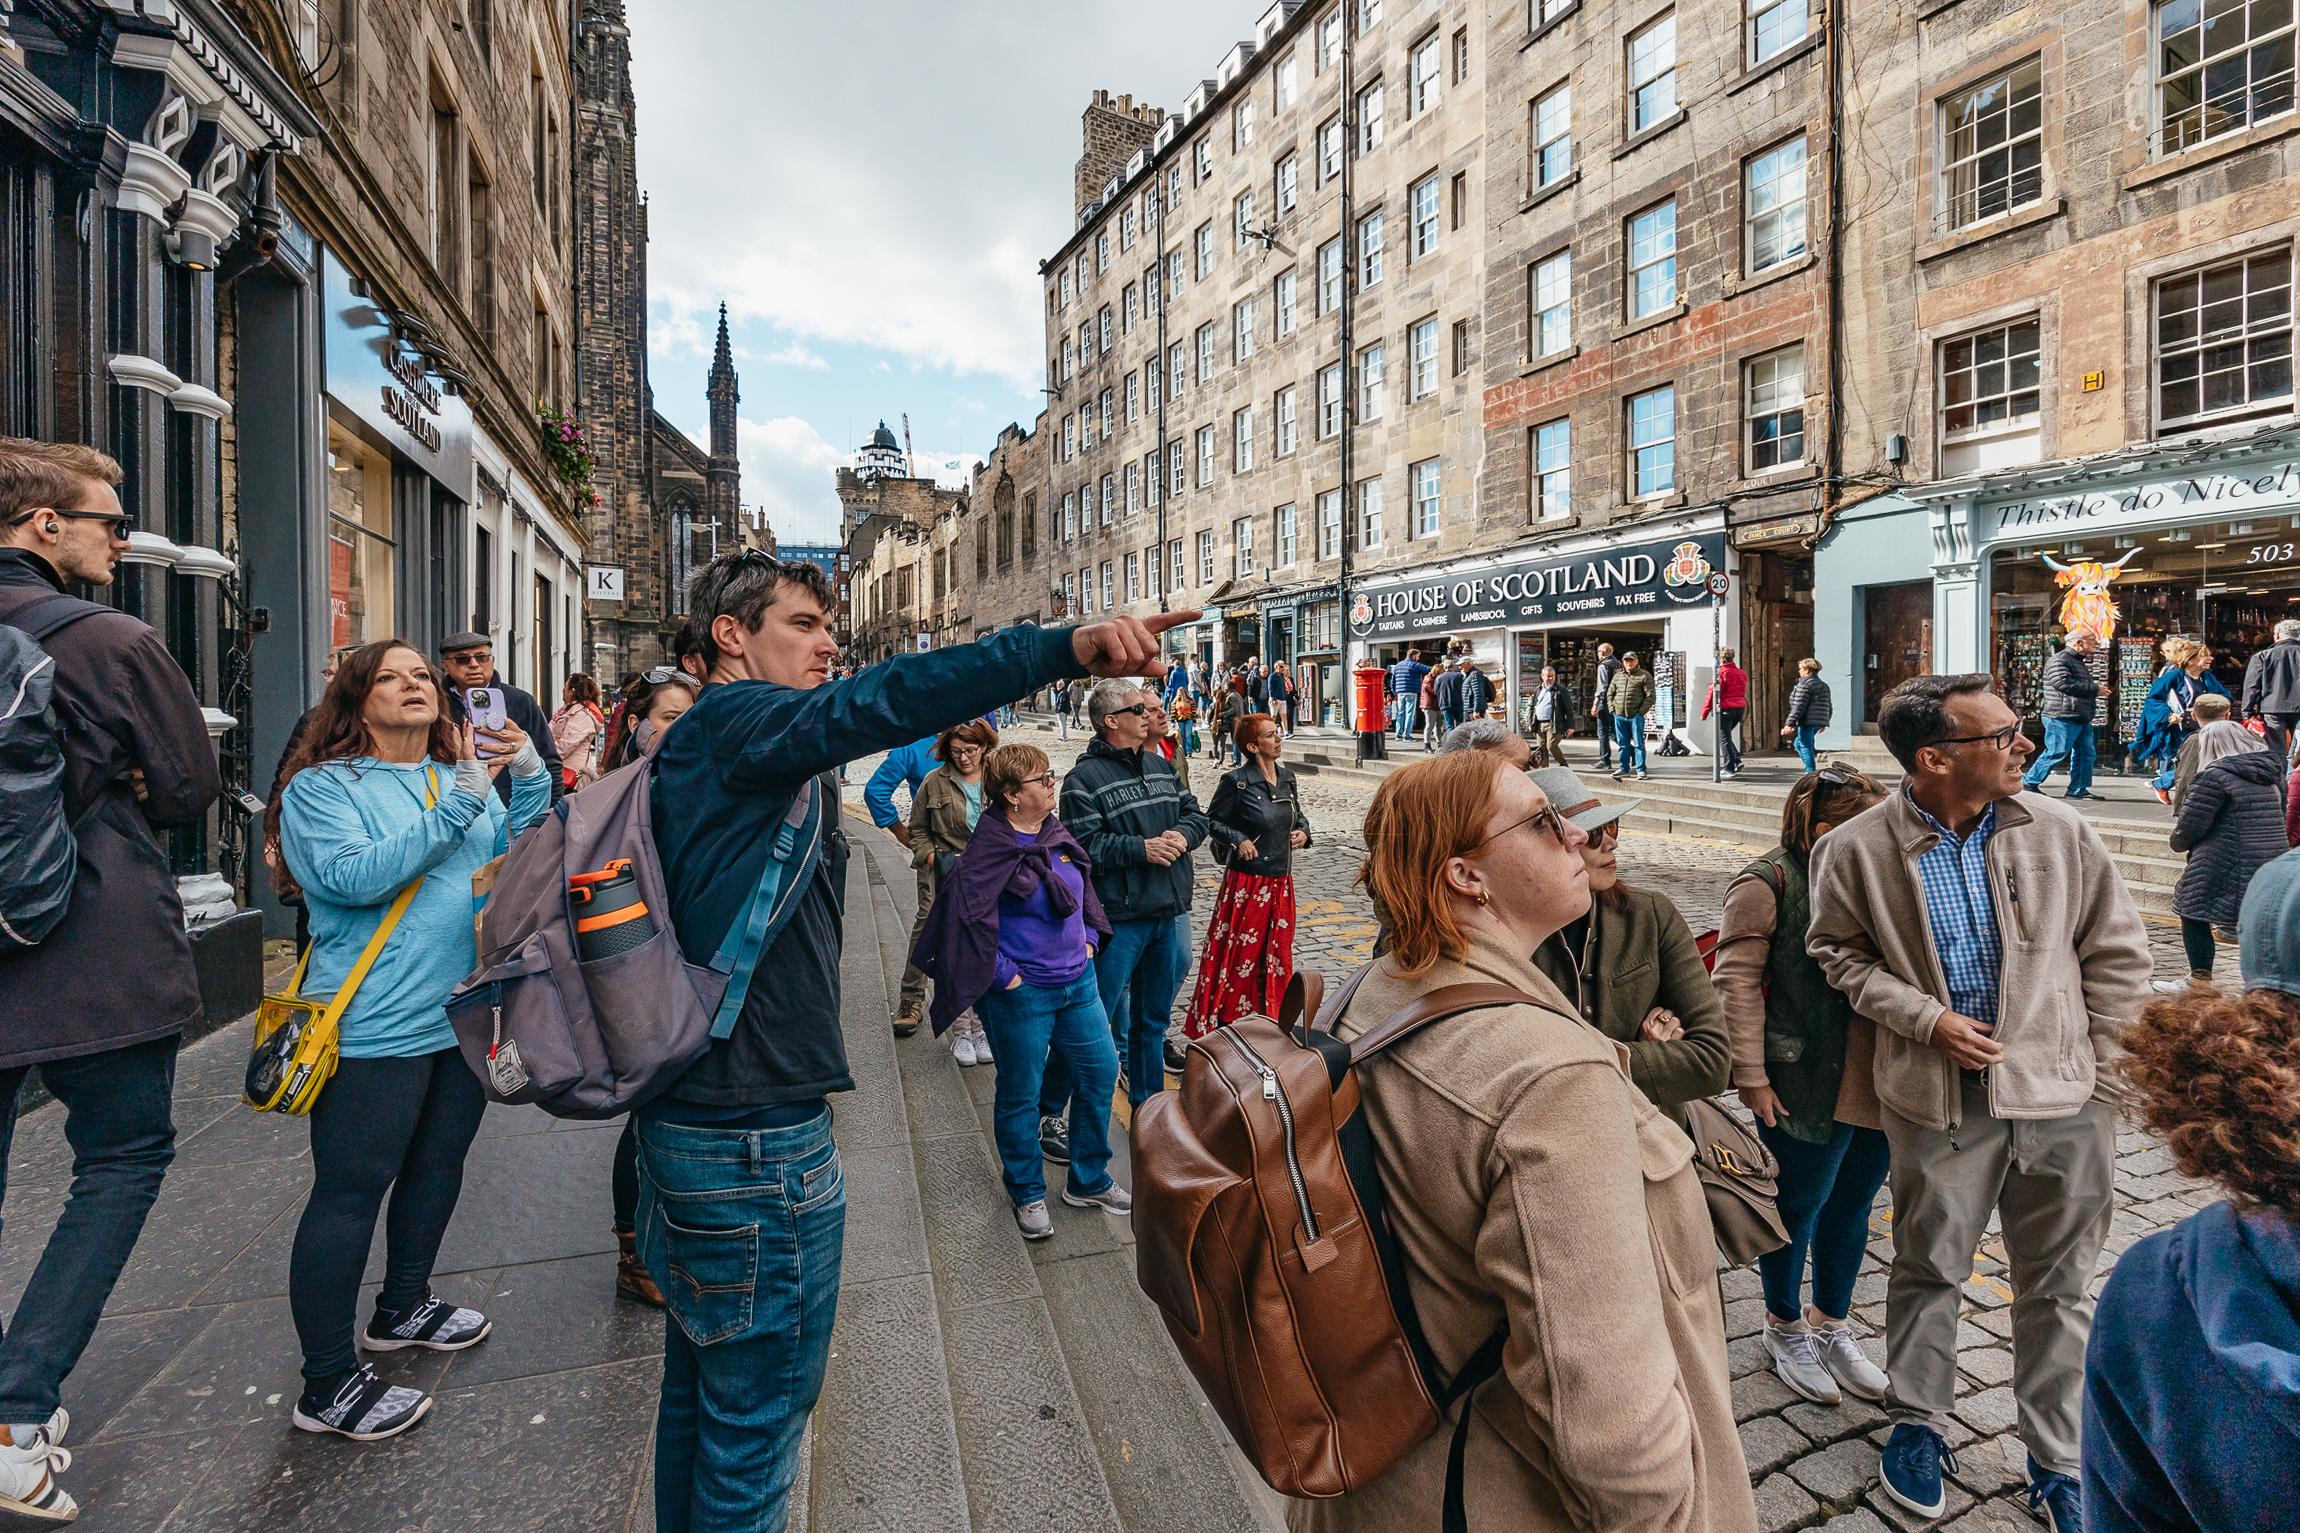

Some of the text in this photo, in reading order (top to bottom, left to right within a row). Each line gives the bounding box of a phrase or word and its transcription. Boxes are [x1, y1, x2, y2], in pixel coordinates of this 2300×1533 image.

[389, 344, 441, 414] CASHMERE
[390, 387, 441, 453] SCOTLAND
[1996, 494, 2105, 529] Thistle
[2120, 486, 2164, 512] do
[2247, 543, 2294, 564] 503
[598, 571, 614, 590] K
[1377, 584, 1447, 618] HOUSE
[1452, 579, 1485, 608] OF
[1489, 554, 1656, 603] SCOTLAND
[1712, 578, 1727, 589] 20
[1378, 620, 1405, 631] TARTANS
[1413, 615, 1448, 627] CASHMERE
[1461, 608, 1507, 622] LAMBSWOOL
[1521, 604, 1543, 616] GIFTS
[1556, 597, 1606, 613] SOUVENIRS
[1615, 594, 1632, 606] TAX
[1634, 591, 1656, 604] FREE
